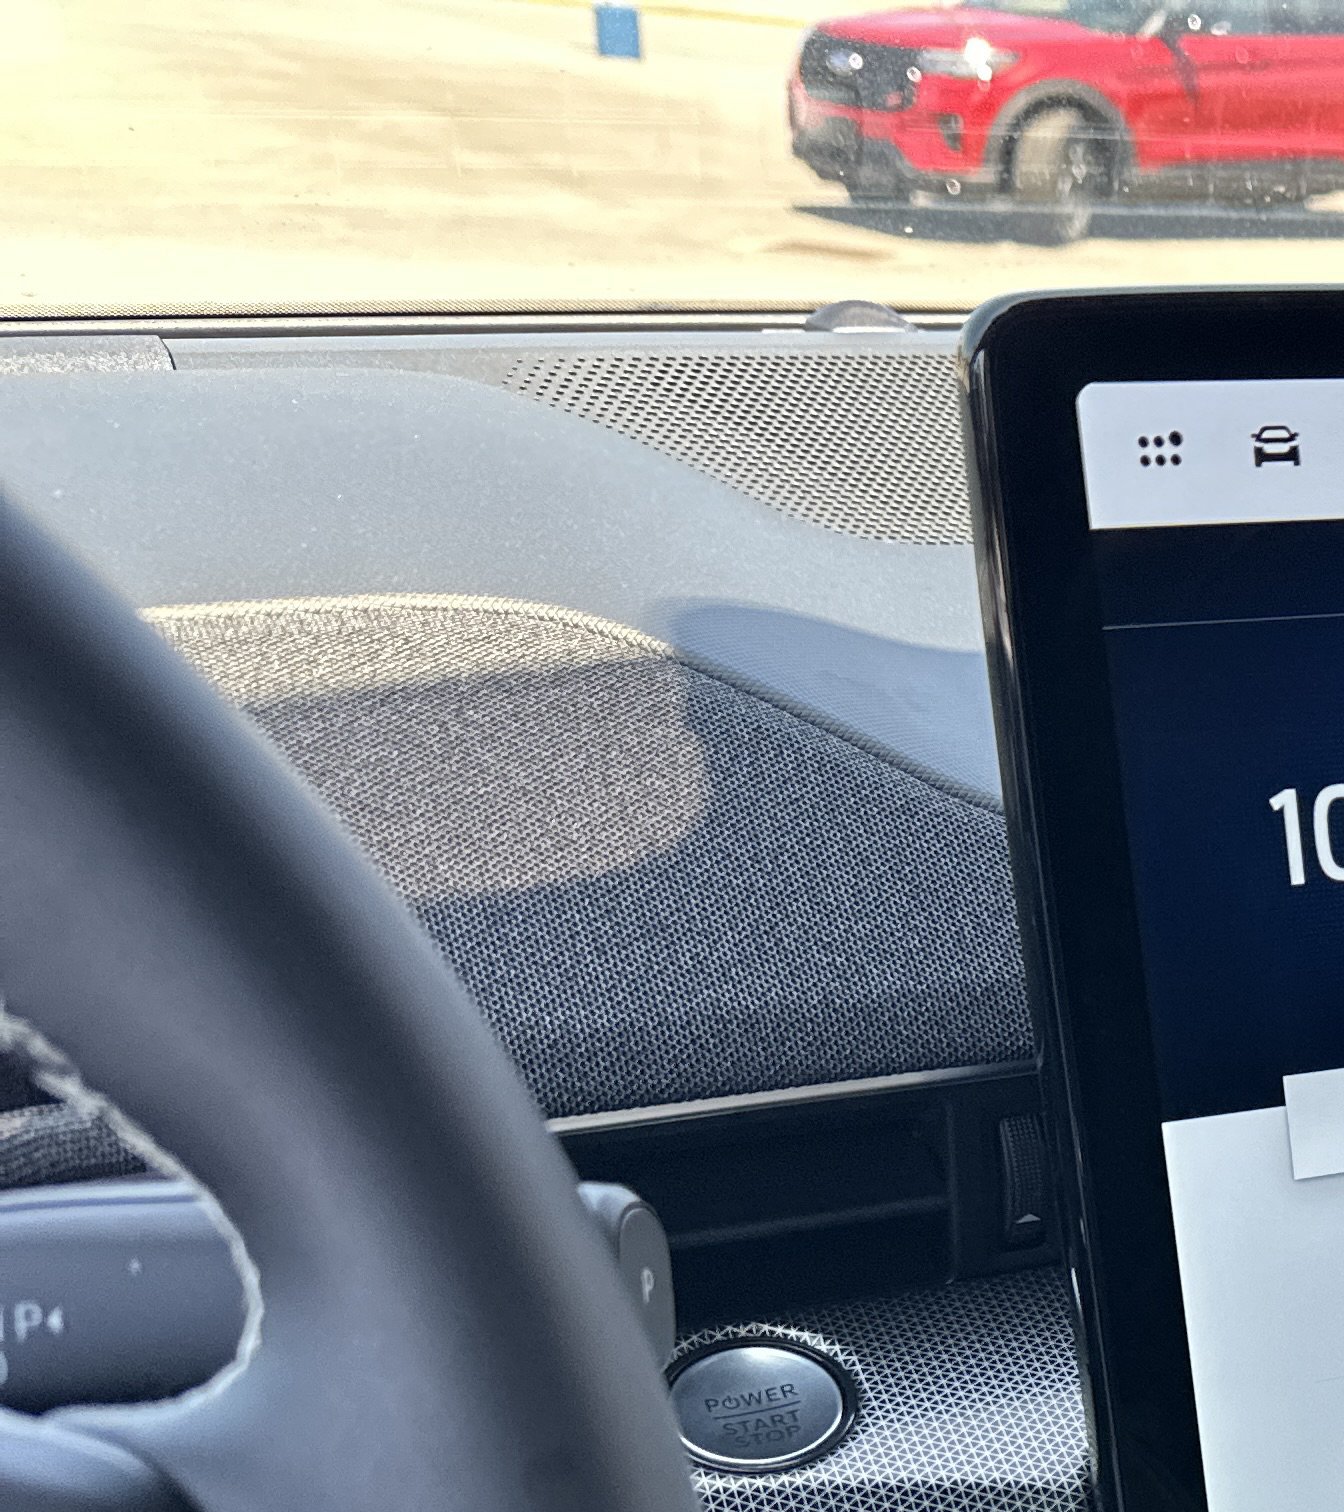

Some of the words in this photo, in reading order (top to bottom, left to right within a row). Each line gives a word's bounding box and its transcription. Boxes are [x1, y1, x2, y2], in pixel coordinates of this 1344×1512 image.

[705, 1384, 799, 1412] POWER
[723, 1411, 800, 1436] START
[736, 1426, 801, 1448] STOP
